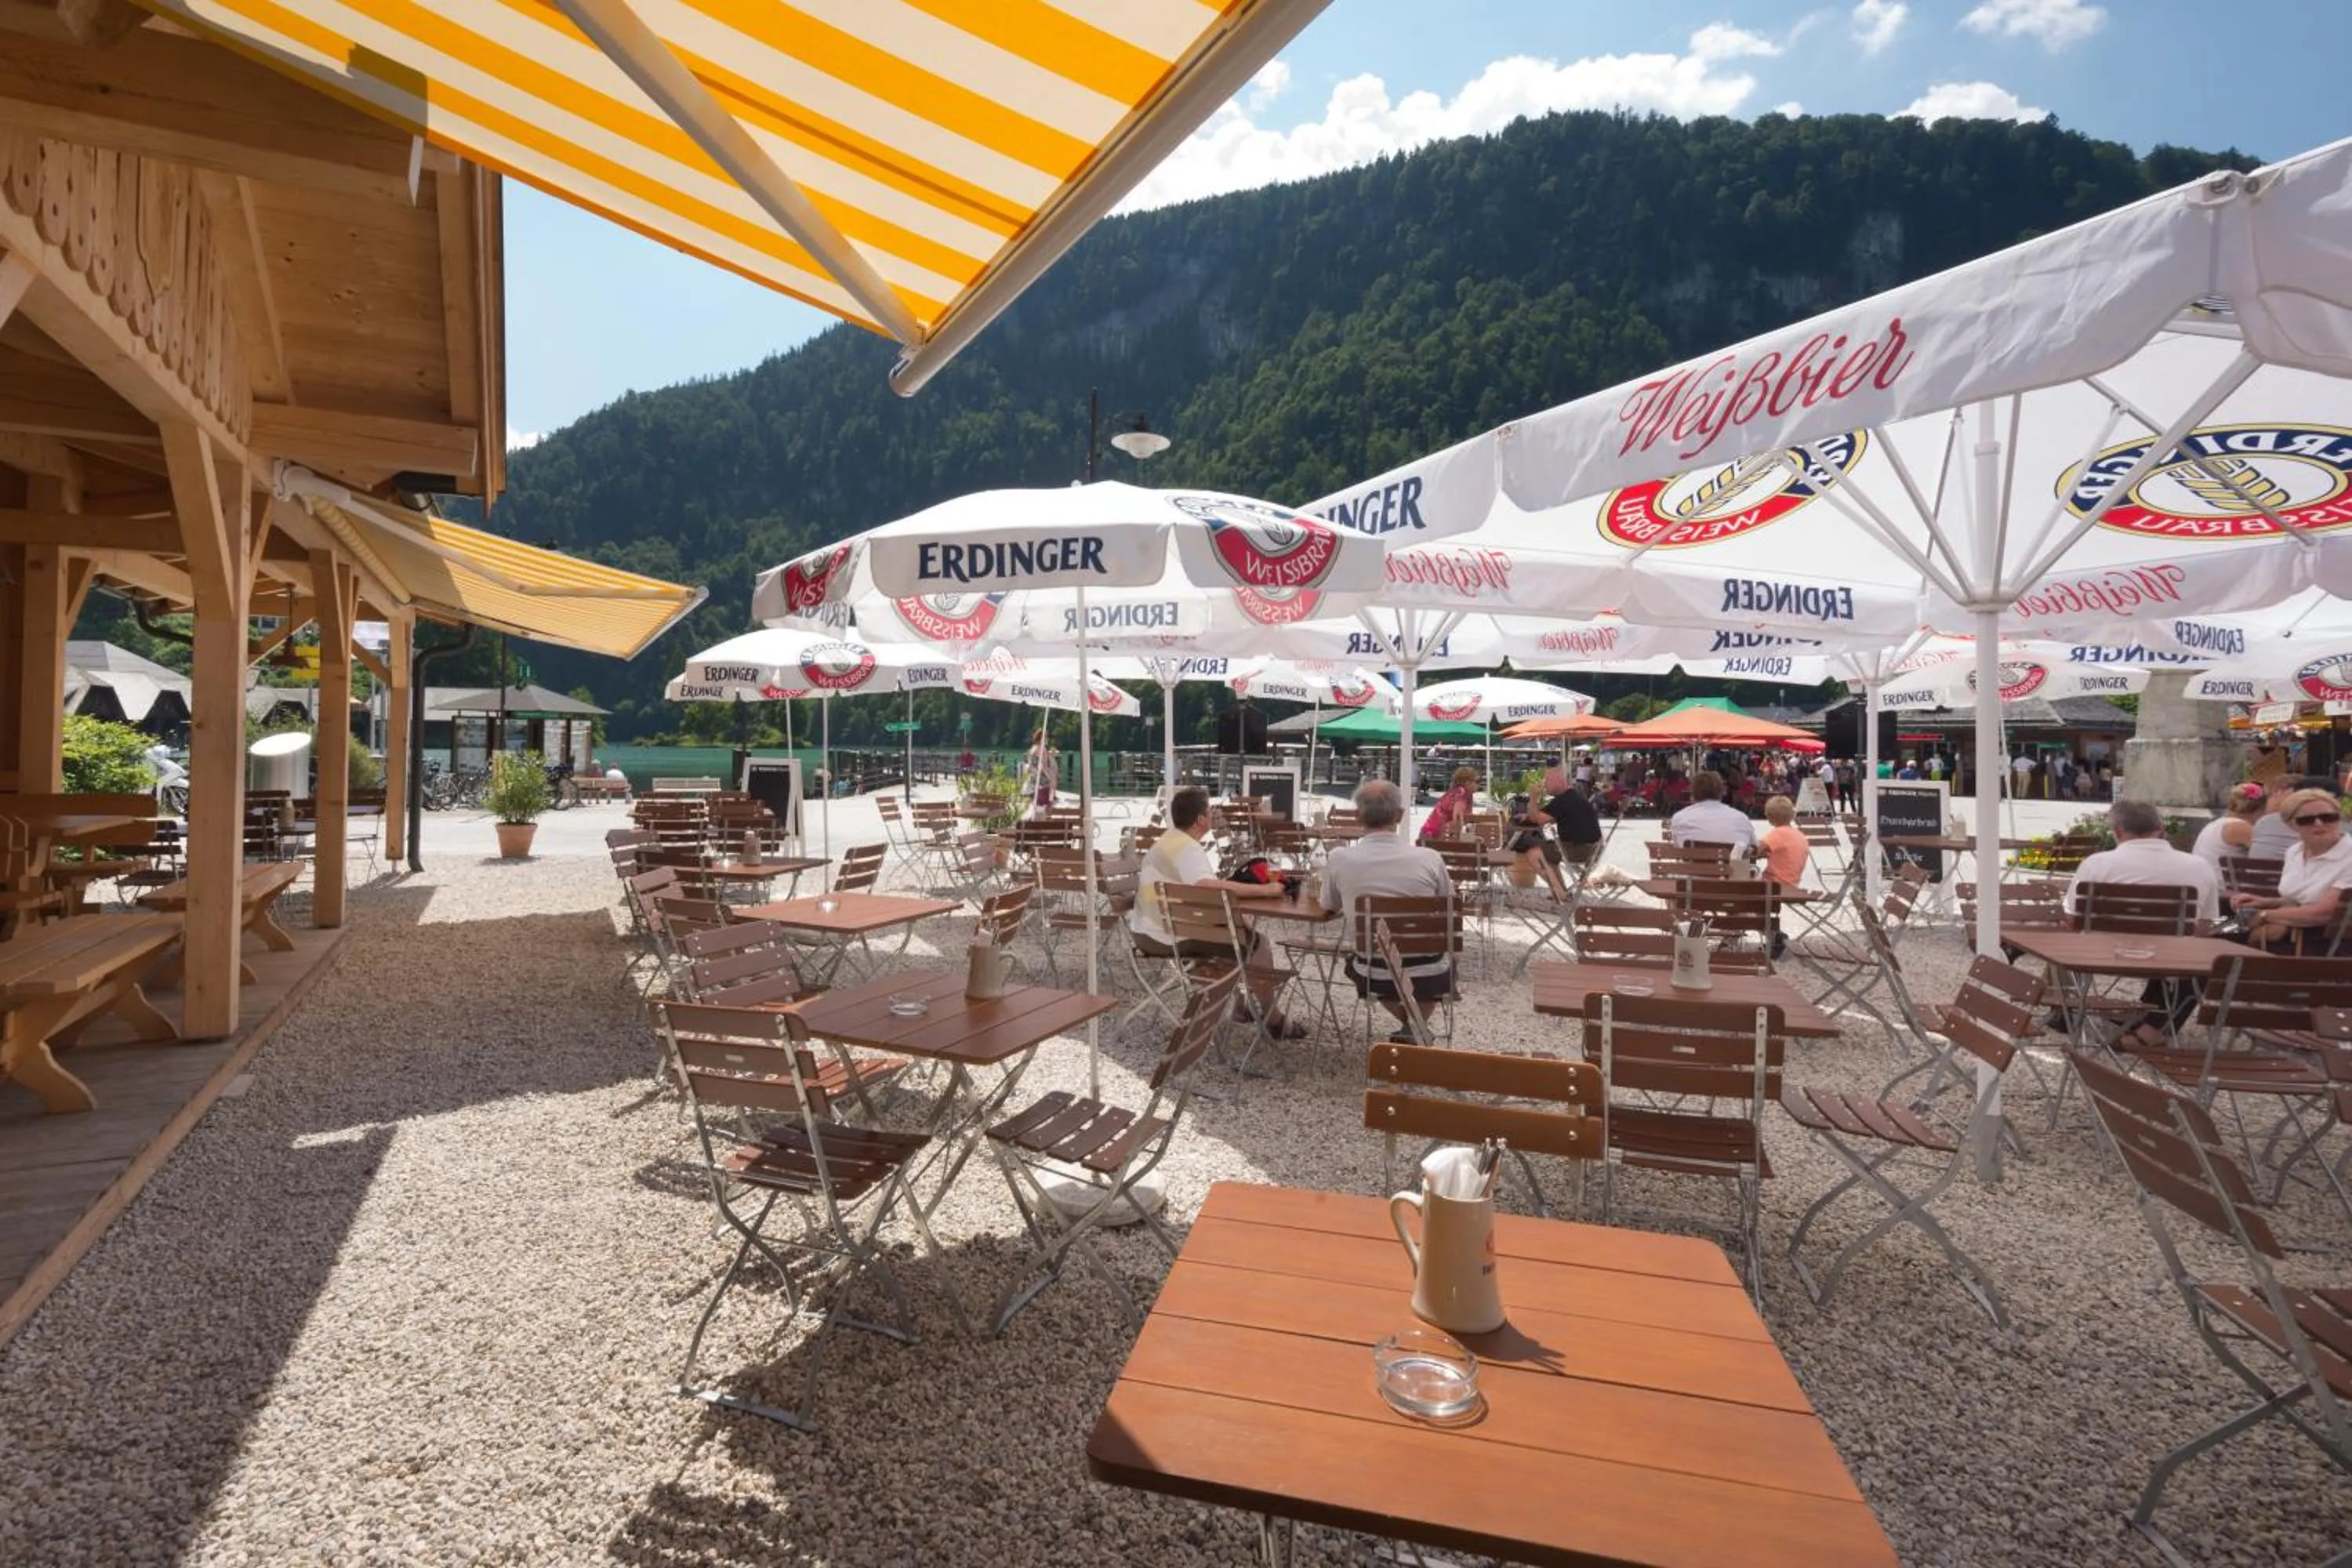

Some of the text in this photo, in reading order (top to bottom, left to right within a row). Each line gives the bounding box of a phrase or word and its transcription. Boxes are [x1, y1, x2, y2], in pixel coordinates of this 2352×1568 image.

[1618, 317, 1915, 461] Weißbier
[918, 537, 1108, 583] ERDINGER
[704, 666, 760, 684] ERDINGER
[1011, 684, 1062, 702] ERDINGER
[1263, 683, 1308, 698] ERDINGER
[2201, 680, 2256, 697] ERDINGER
[1882, 690, 1935, 706] ERDINGER
